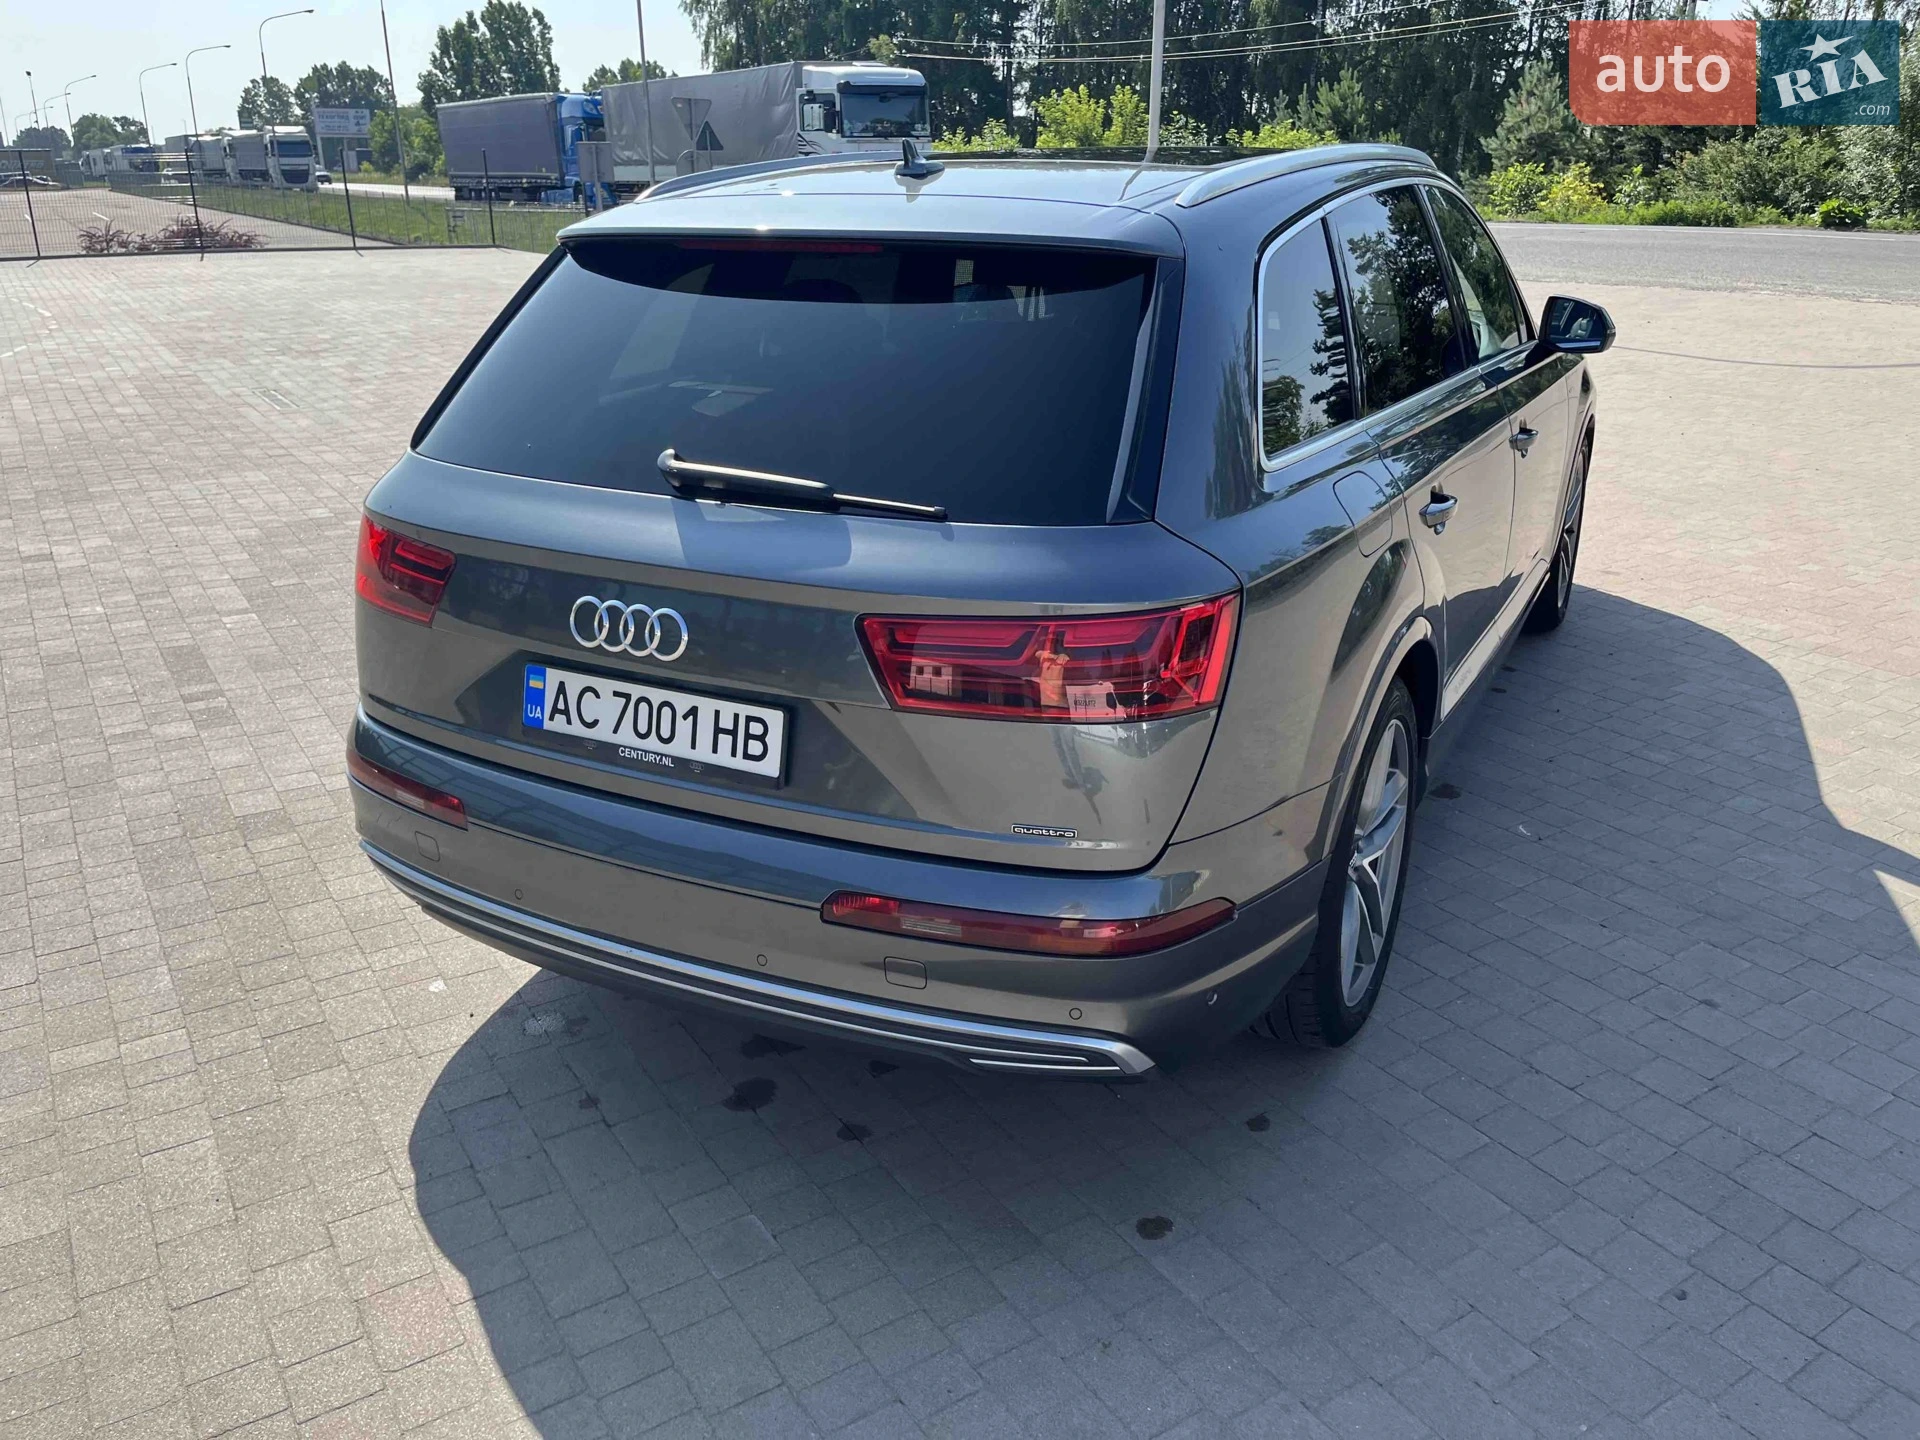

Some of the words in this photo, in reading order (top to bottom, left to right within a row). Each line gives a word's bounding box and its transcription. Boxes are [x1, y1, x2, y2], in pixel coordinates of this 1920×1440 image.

[527, 704, 543, 720] UA
[548, 680, 602, 729] AC
[612, 690, 699, 750] 7001
[711, 709, 769, 762] HB
[618, 747, 675, 767] CENTURY.NL
[1014, 827, 1074, 837] quattro
